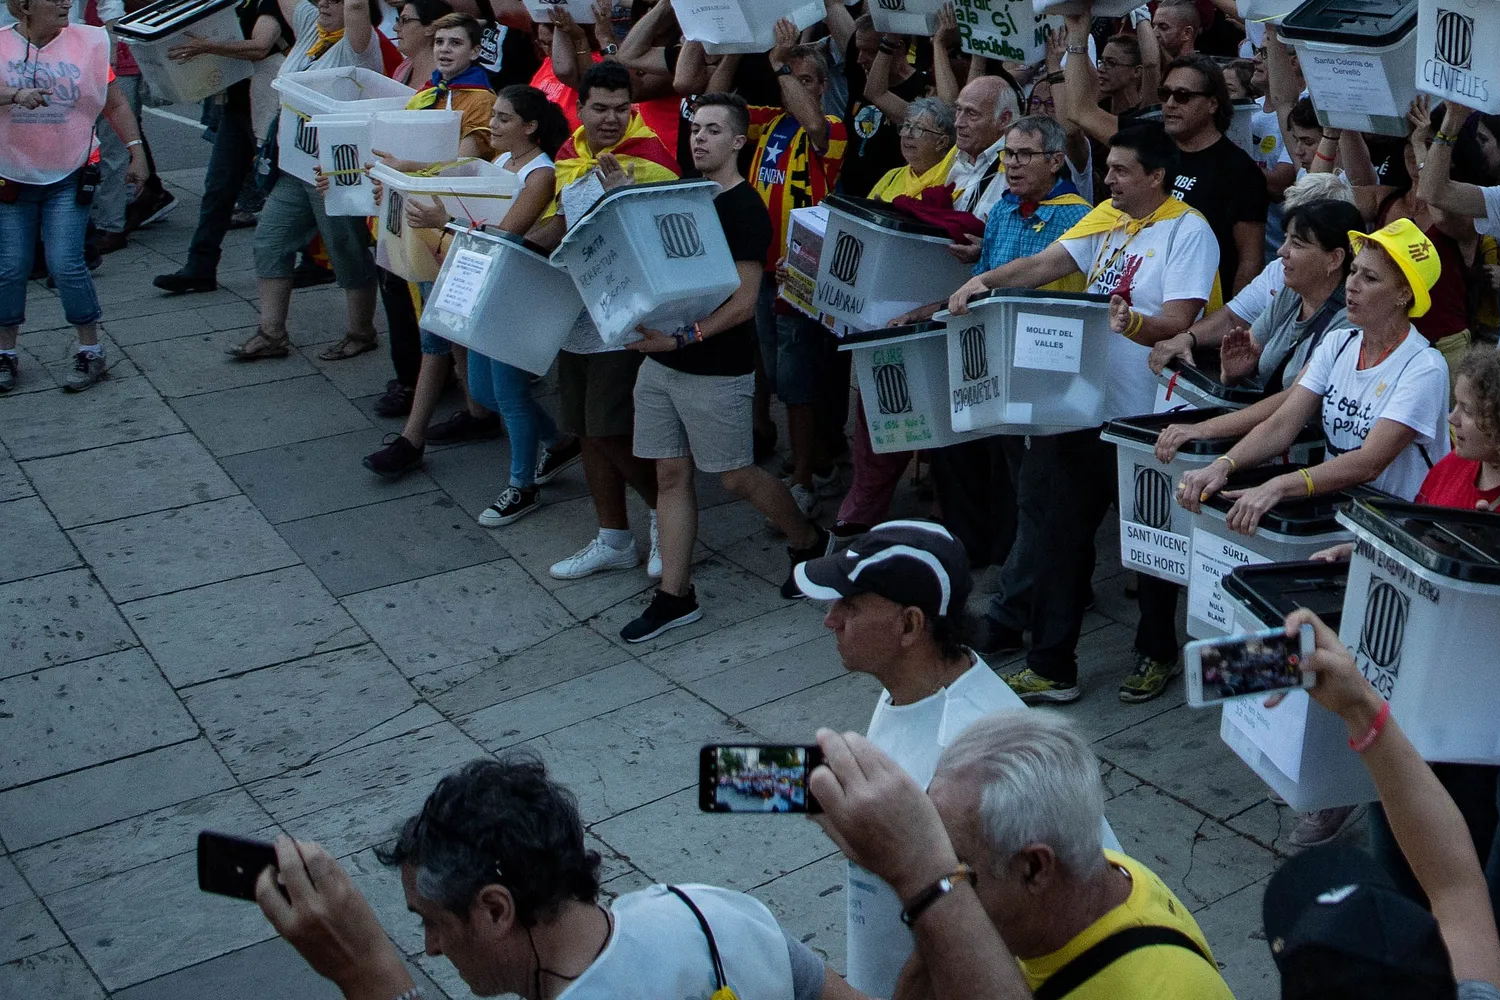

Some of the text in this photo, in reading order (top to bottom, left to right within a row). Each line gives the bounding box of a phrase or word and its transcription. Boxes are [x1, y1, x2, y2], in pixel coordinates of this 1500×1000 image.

[959, 23, 1025, 60] República
[1314, 56, 1374, 68] Santa Coloma de
[1424, 59, 1489, 103] CENTELLES
[582, 234, 607, 262] SANTA
[817, 281, 865, 315] VILADRAU
[1026, 326, 1074, 338] MOLLET DEL
[1034, 340, 1064, 349] VALLES
[1127, 525, 1189, 555] SANT VICENÇ
[1130, 549, 1152, 566] DELS
[1154, 555, 1186, 575] HORTS
[1222, 545, 1250, 564] SÚRIA
[1202, 564, 1219, 578] TOTAL
[1213, 591, 1222, 601] NO
[1208, 600, 1224, 614] NULS
[1207, 610, 1226, 625] BLANC
